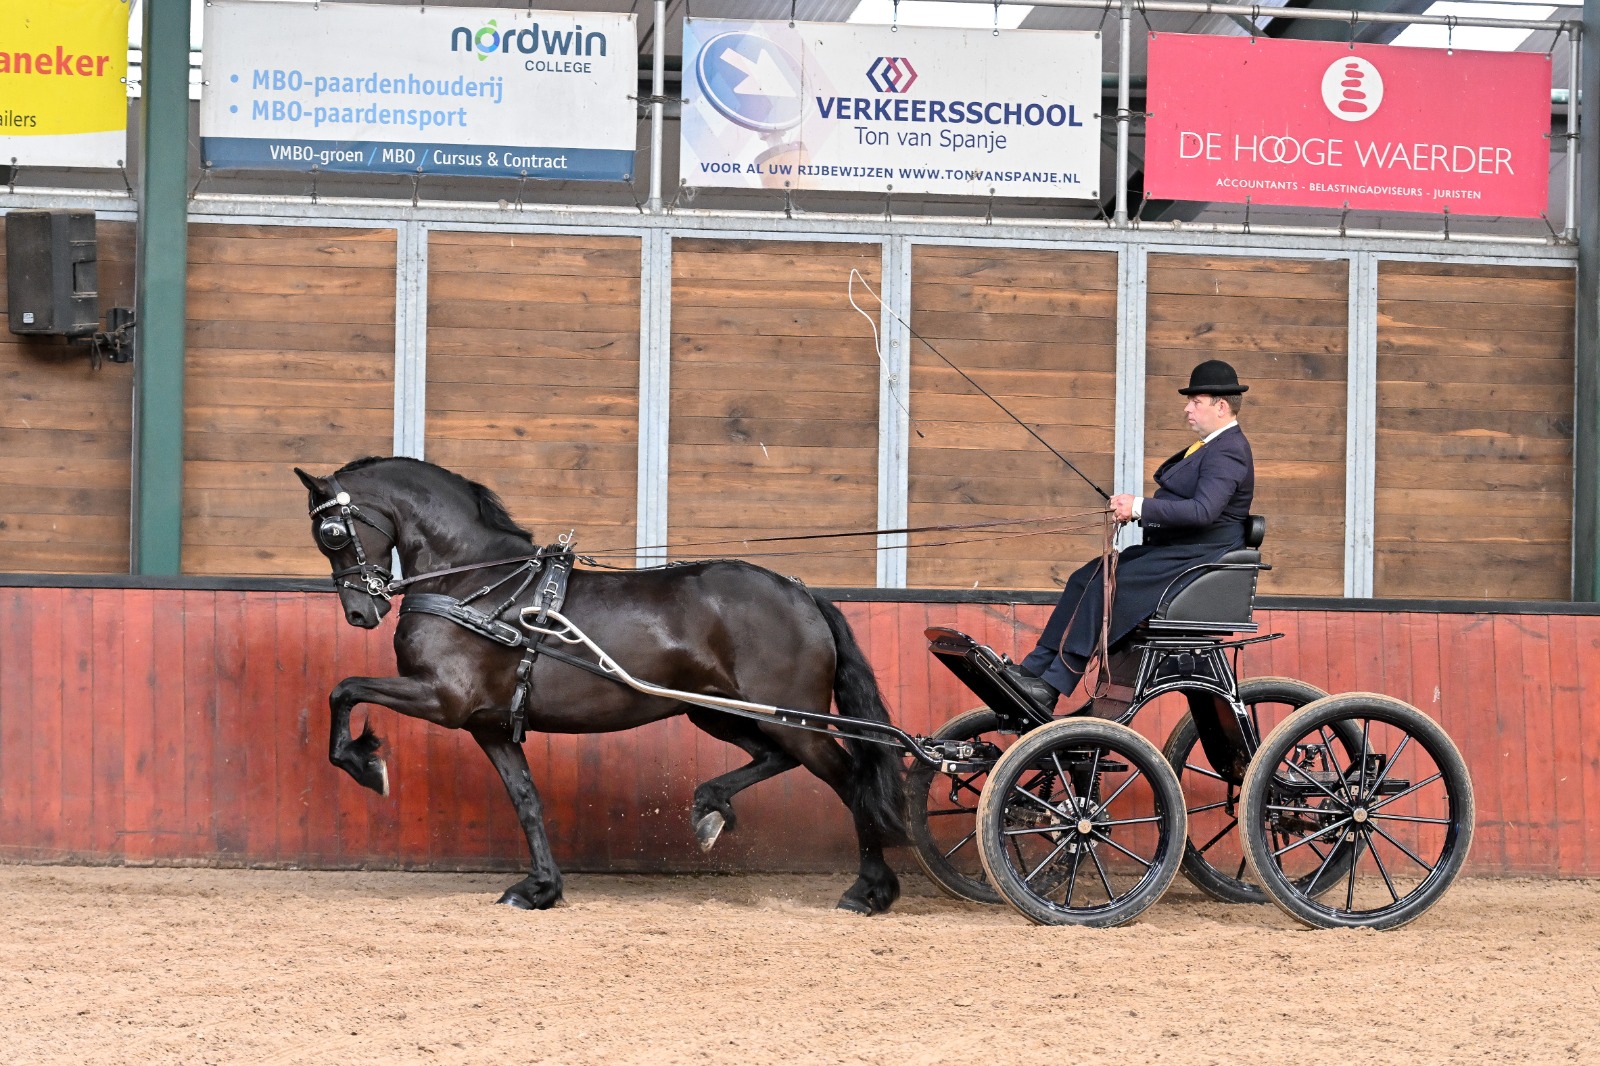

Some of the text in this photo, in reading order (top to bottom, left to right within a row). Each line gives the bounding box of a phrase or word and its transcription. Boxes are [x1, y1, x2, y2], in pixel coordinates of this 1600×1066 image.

[451, 19, 607, 61] nordwin
[524, 60, 592, 74] COLLEGE
[251, 69, 503, 104] MBO-paardenhouderij
[251, 100, 467, 131] MBO-paardensport
[815, 96, 1083, 127] VERKEERSSCHOOL
[854, 127, 1008, 154] Ton van Spanje
[1179, 131, 1515, 175] DE HOOGE WAERDER
[269, 145, 364, 165] VMBO-groen
[381, 149, 416, 165] MBO
[433, 150, 482, 167] Cursus
[487, 152, 499, 167] &
[503, 152, 568, 169] Contract
[700, 162, 1081, 184] VOOR AL UW RIJBEWIJZEN WWW.TONVANSPANJE.NL
[1216, 178, 1298, 190] ACCOUNTANTS
[1309, 183, 1423, 197] BELASTINGADVISEURS
[1433, 188, 1482, 200] JURISTEN
